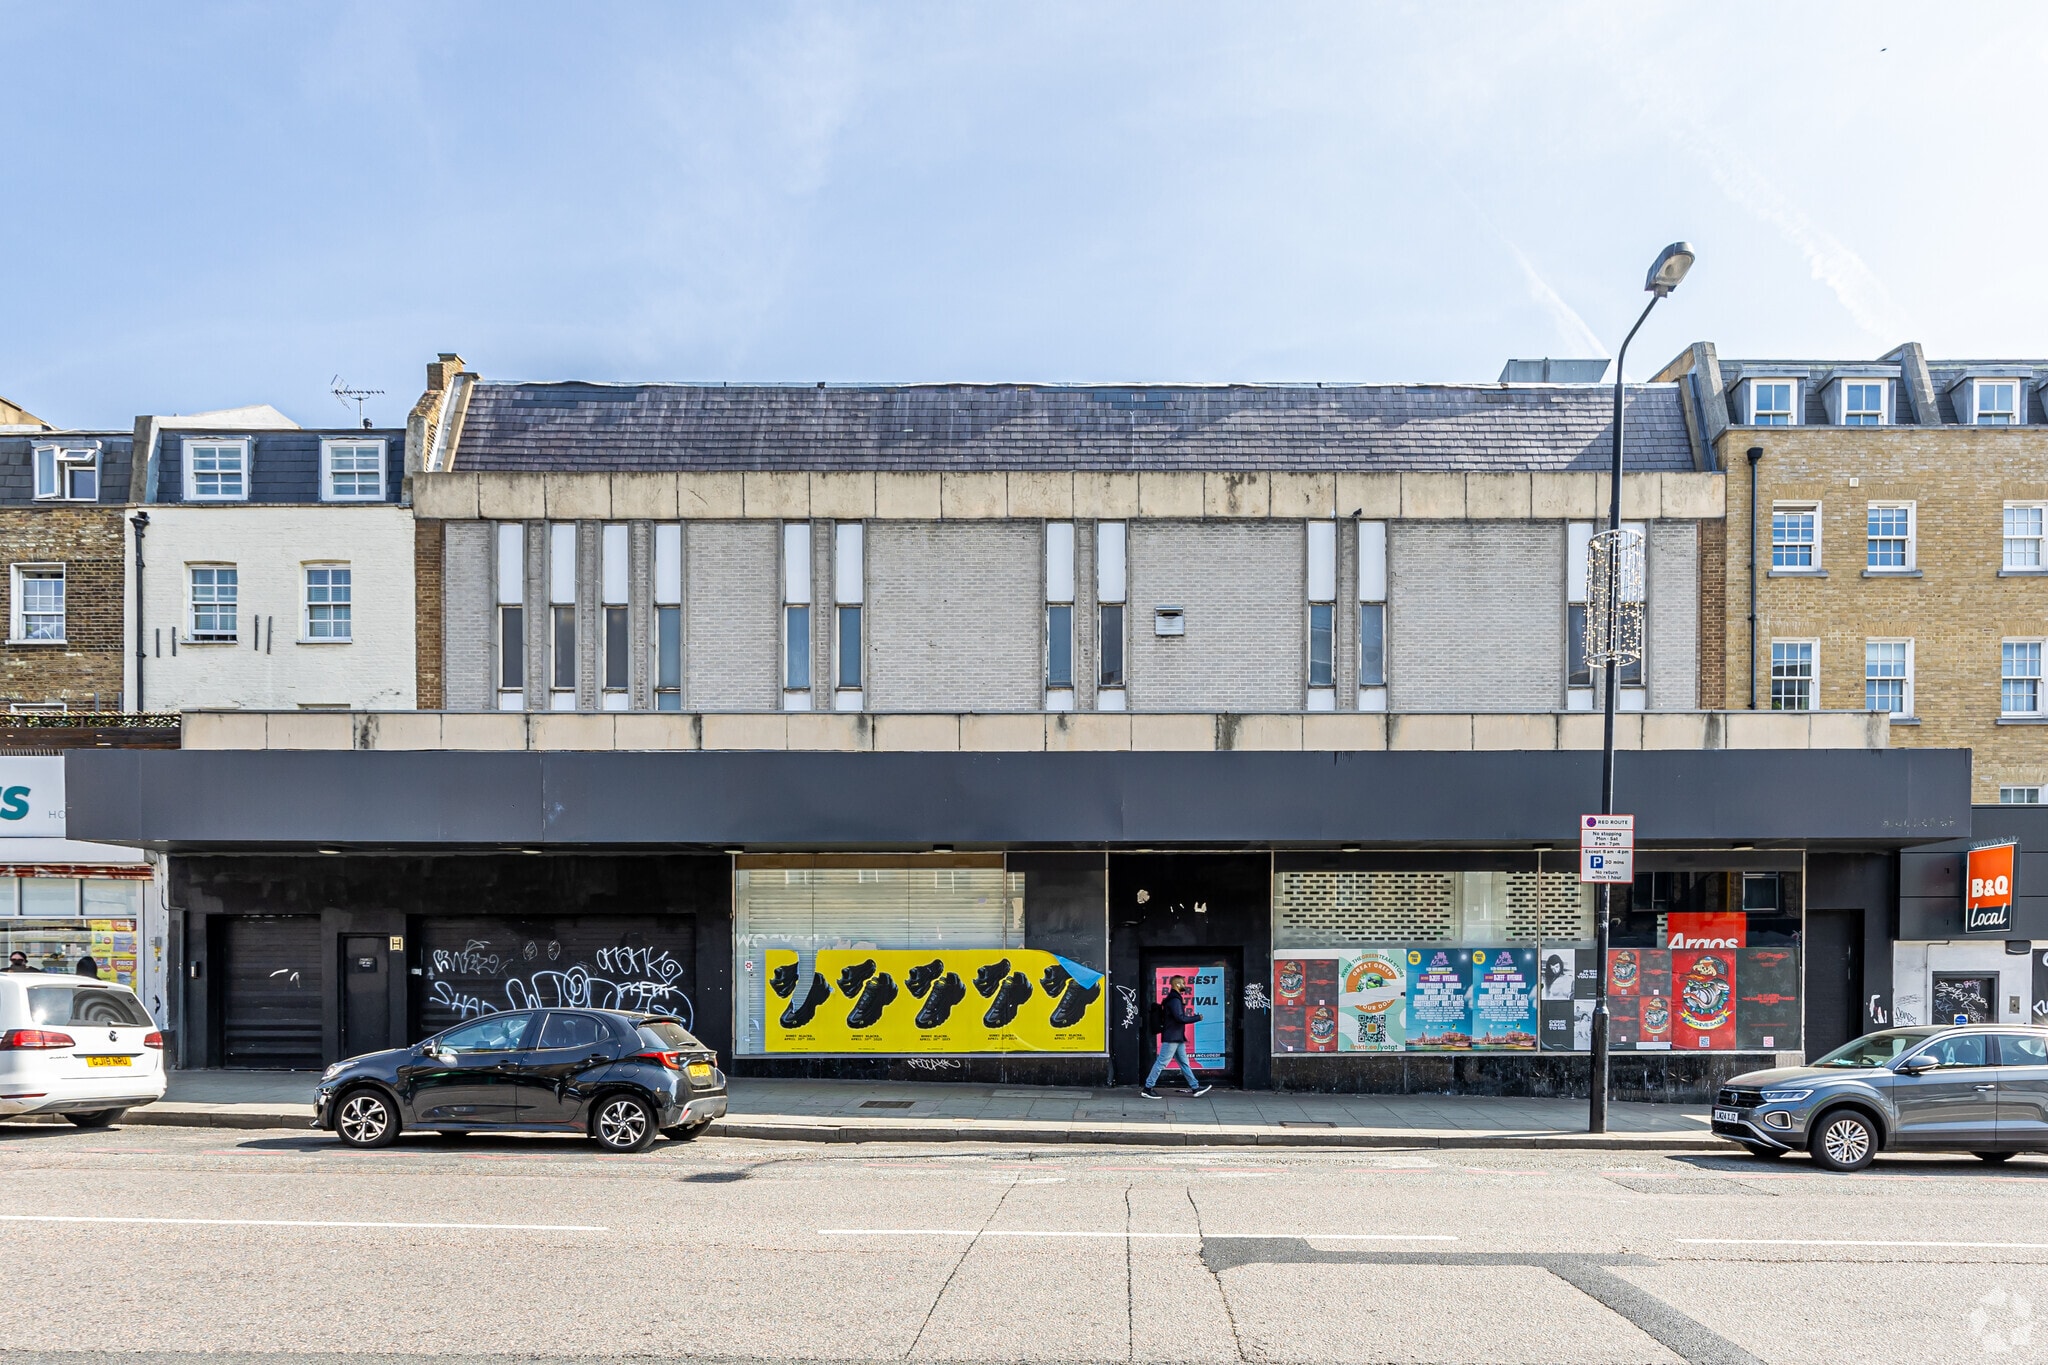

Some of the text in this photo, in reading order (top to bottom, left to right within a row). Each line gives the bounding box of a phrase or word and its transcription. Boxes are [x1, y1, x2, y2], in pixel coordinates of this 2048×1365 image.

[1593, 857, 1602, 868] P
[1971, 875, 2008, 898] B&Q
[1970, 903, 2007, 927] Local
[1353, 963, 1392, 977] GREAT GREEN
[1188, 976, 1218, 984] BEST
